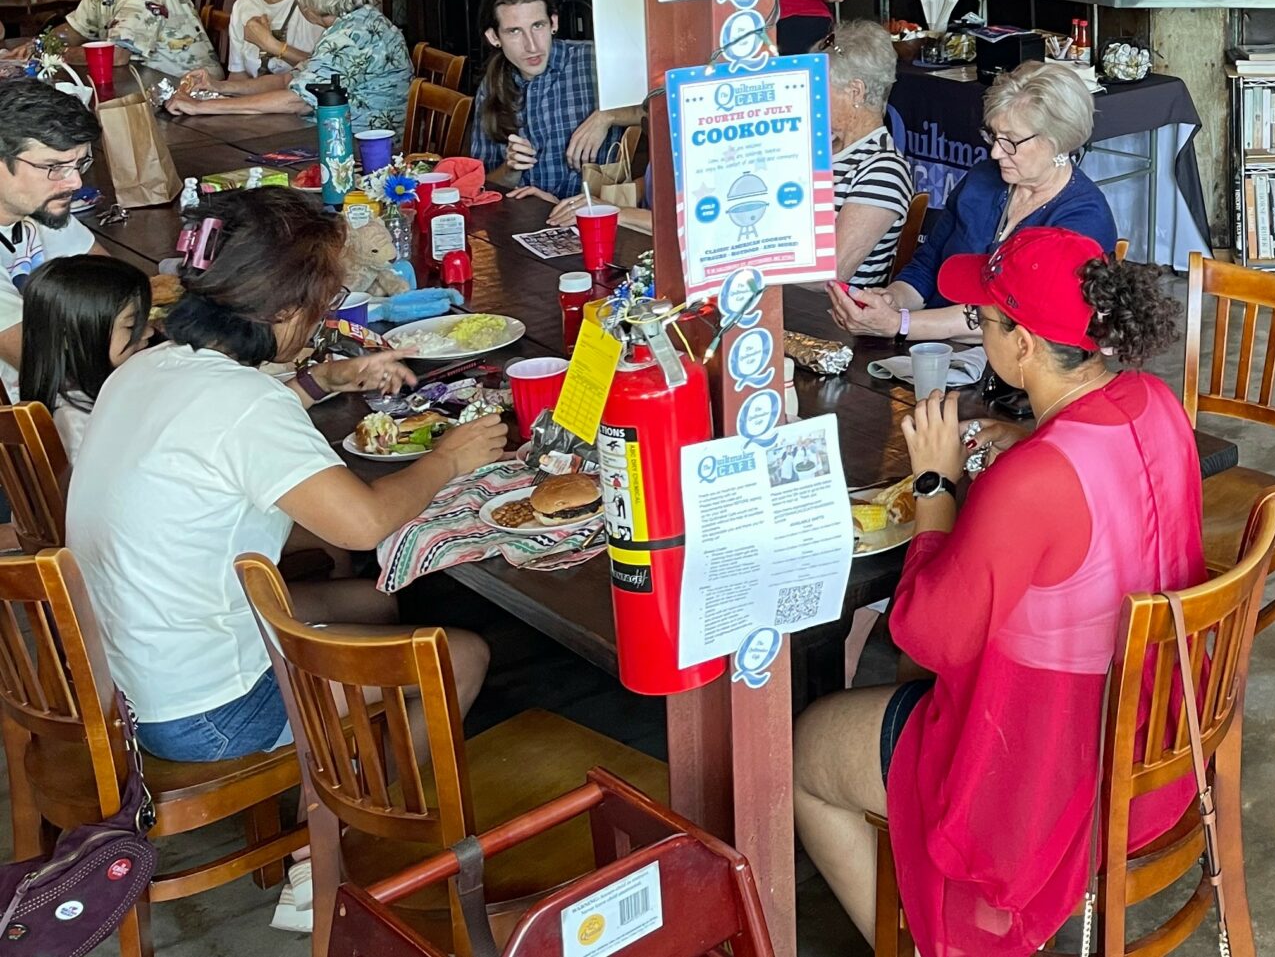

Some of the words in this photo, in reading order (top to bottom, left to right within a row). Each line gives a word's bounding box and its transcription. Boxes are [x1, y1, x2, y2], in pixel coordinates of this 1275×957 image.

[697, 111, 744, 126] FOURTH
[747, 109, 761, 118] OF
[763, 105, 793, 116] JULY
[692, 117, 802, 146] COOKOUT
[704, 246, 730, 255] CLASSIC
[731, 240, 760, 250] AMERICAN
[600, 426, 625, 438] TIONS
[719, 459, 756, 477] CAFE
